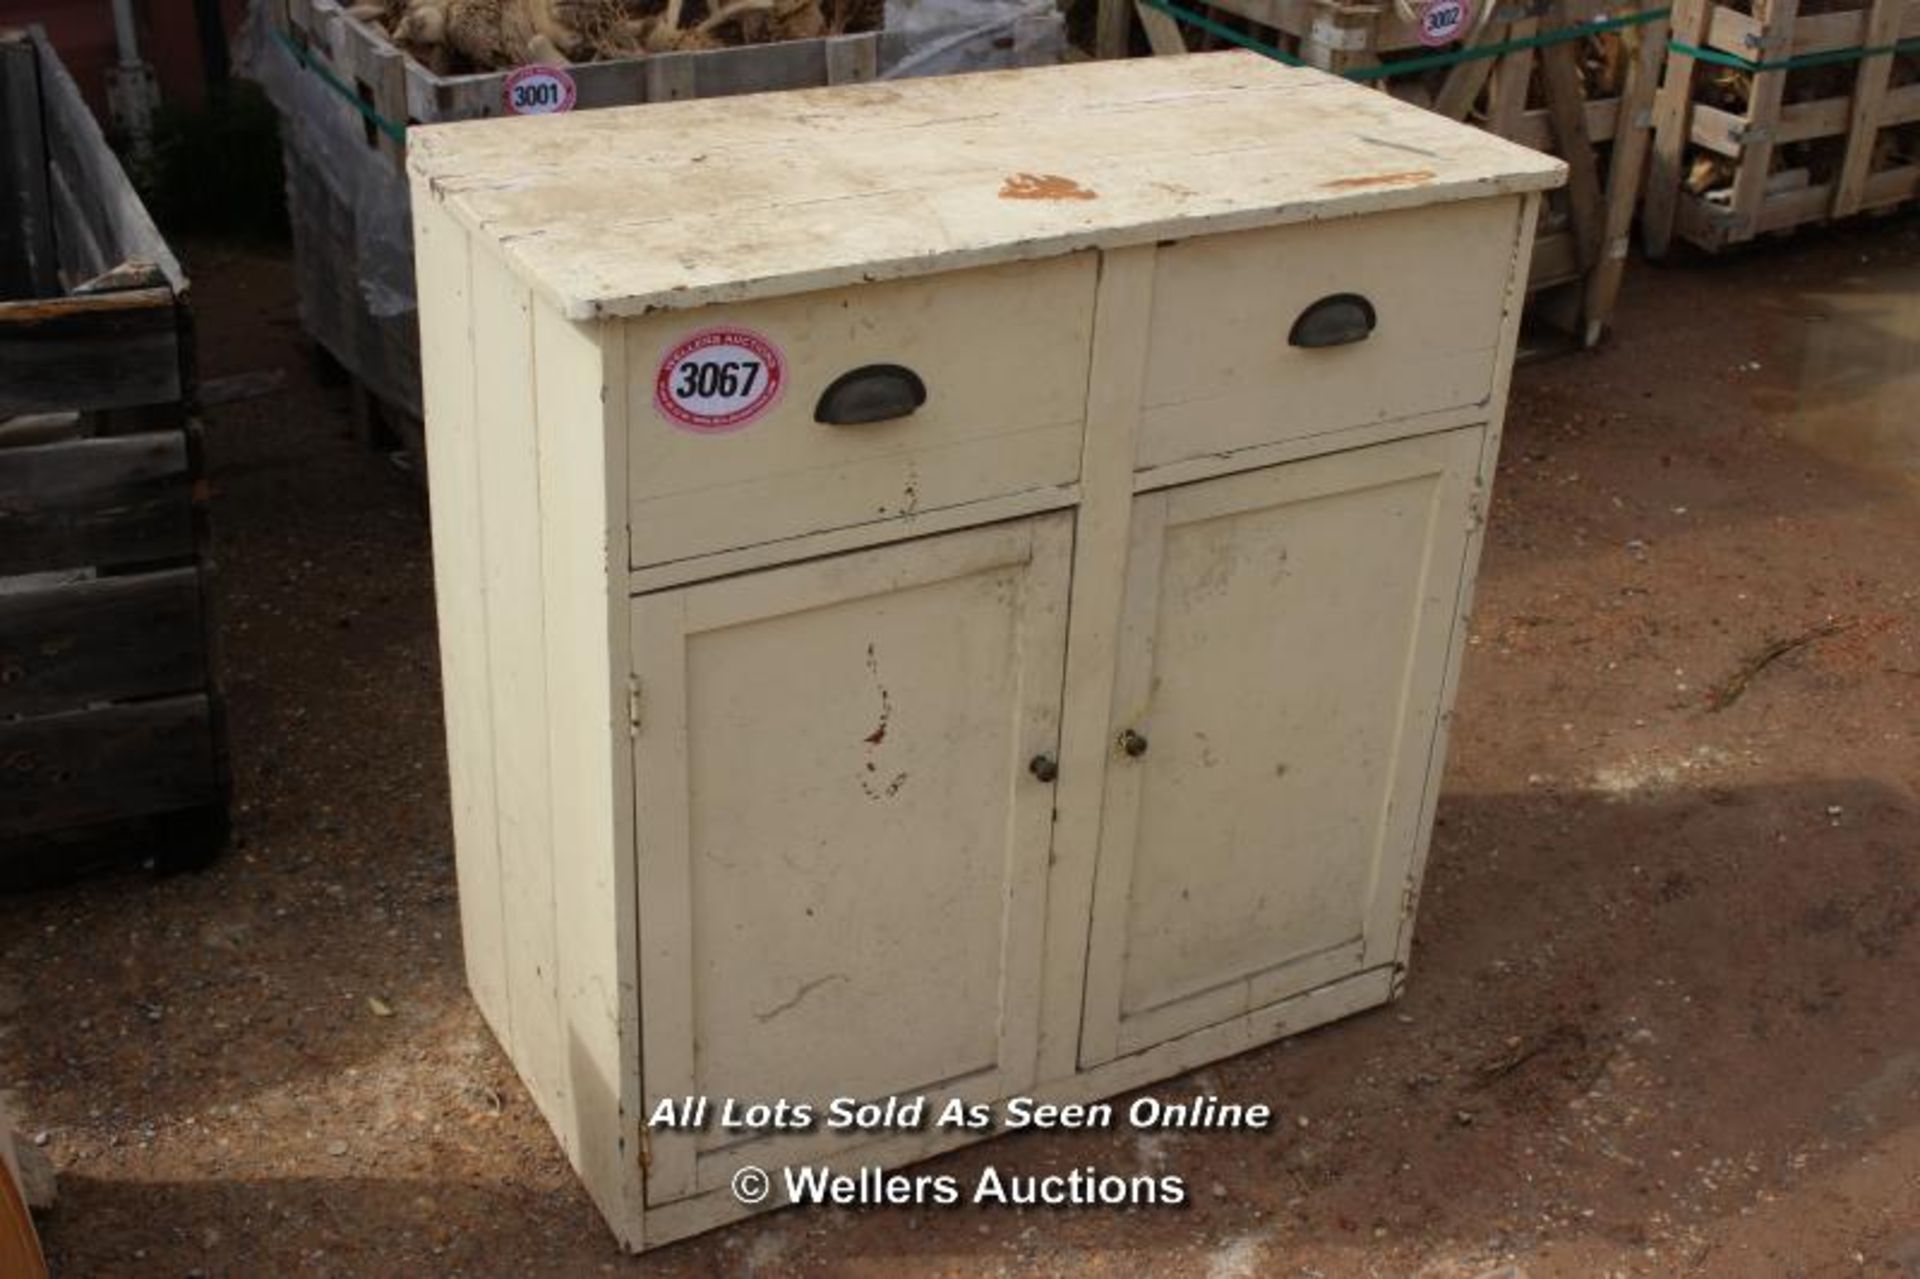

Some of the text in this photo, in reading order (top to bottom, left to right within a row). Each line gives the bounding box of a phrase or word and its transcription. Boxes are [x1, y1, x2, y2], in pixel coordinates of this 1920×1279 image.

[1427, 7, 1460, 31] 3002
[514, 84, 558, 107] 3001
[676, 362, 760, 398] 3067
